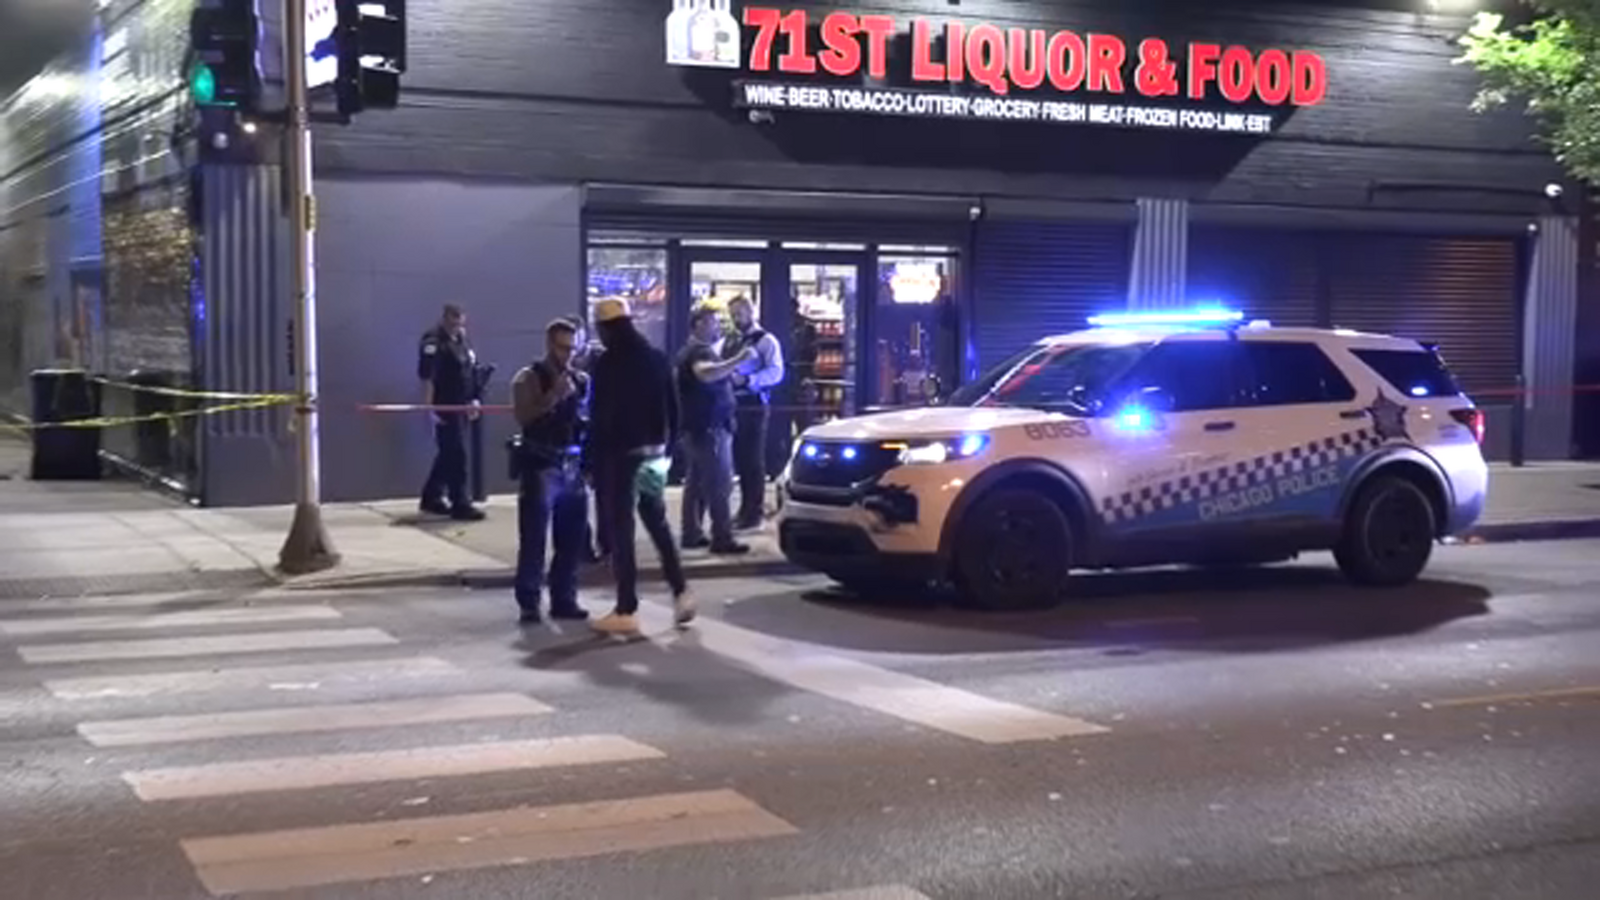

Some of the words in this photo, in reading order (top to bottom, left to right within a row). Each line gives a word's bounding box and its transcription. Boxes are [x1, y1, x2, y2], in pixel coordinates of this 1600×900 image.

[743, 7, 895, 78] 71ST
[912, 16, 1126, 95] LIQUOR
[1134, 37, 1178, 96] &
[1187, 42, 1326, 106] FOOD
[1023, 420, 1091, 441] 8063
[1199, 484, 1274, 521] CHICAGO
[1277, 465, 1340, 497] POLICE
